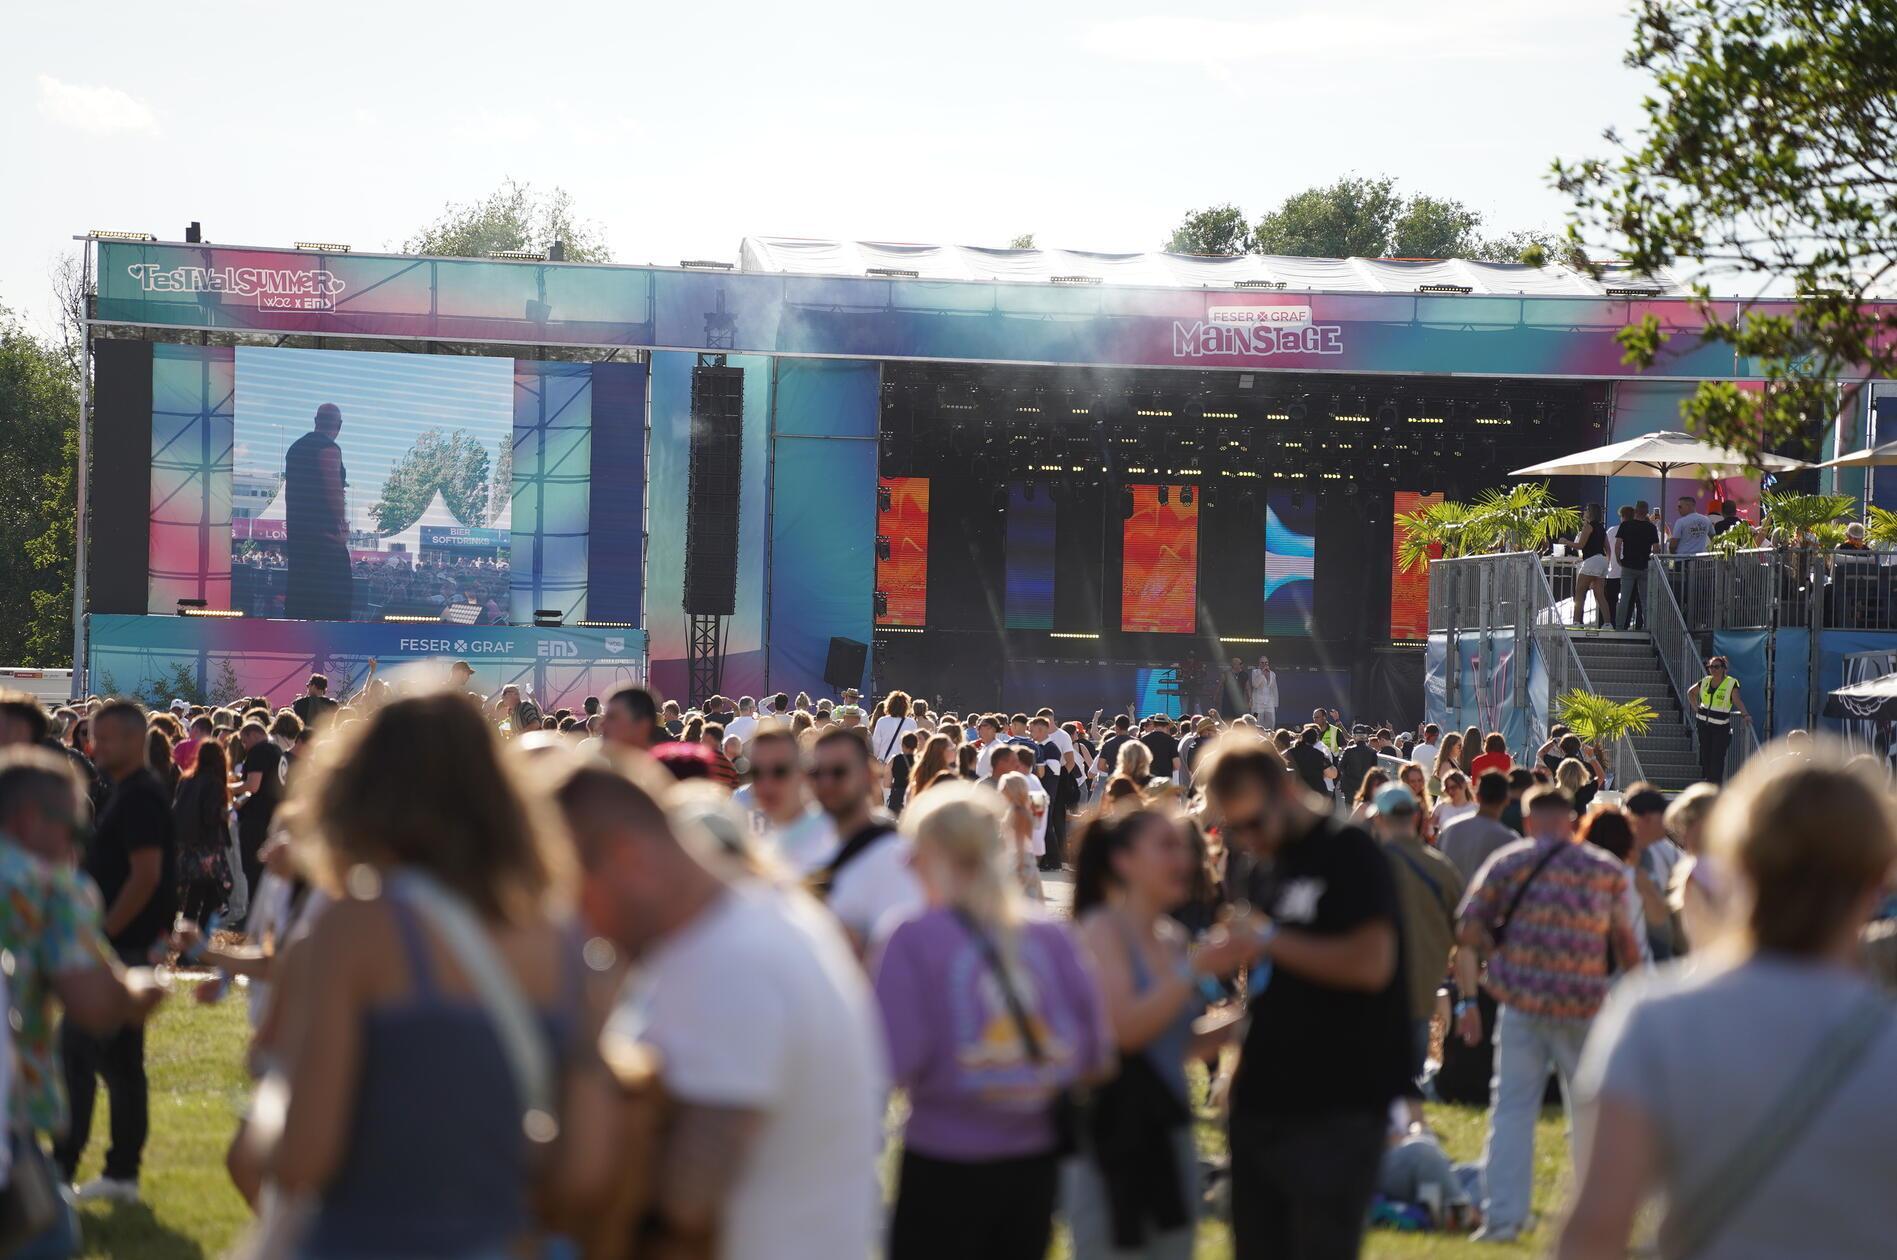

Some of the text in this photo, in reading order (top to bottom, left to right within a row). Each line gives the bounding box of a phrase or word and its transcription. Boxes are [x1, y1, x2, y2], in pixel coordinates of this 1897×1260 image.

[1213, 311, 1306, 322] FESER GRAF
[450, 527, 471, 536] BIER
[432, 535, 490, 545] SOFTDRINKS
[400, 638, 578, 657] FESER GRAF EMS
